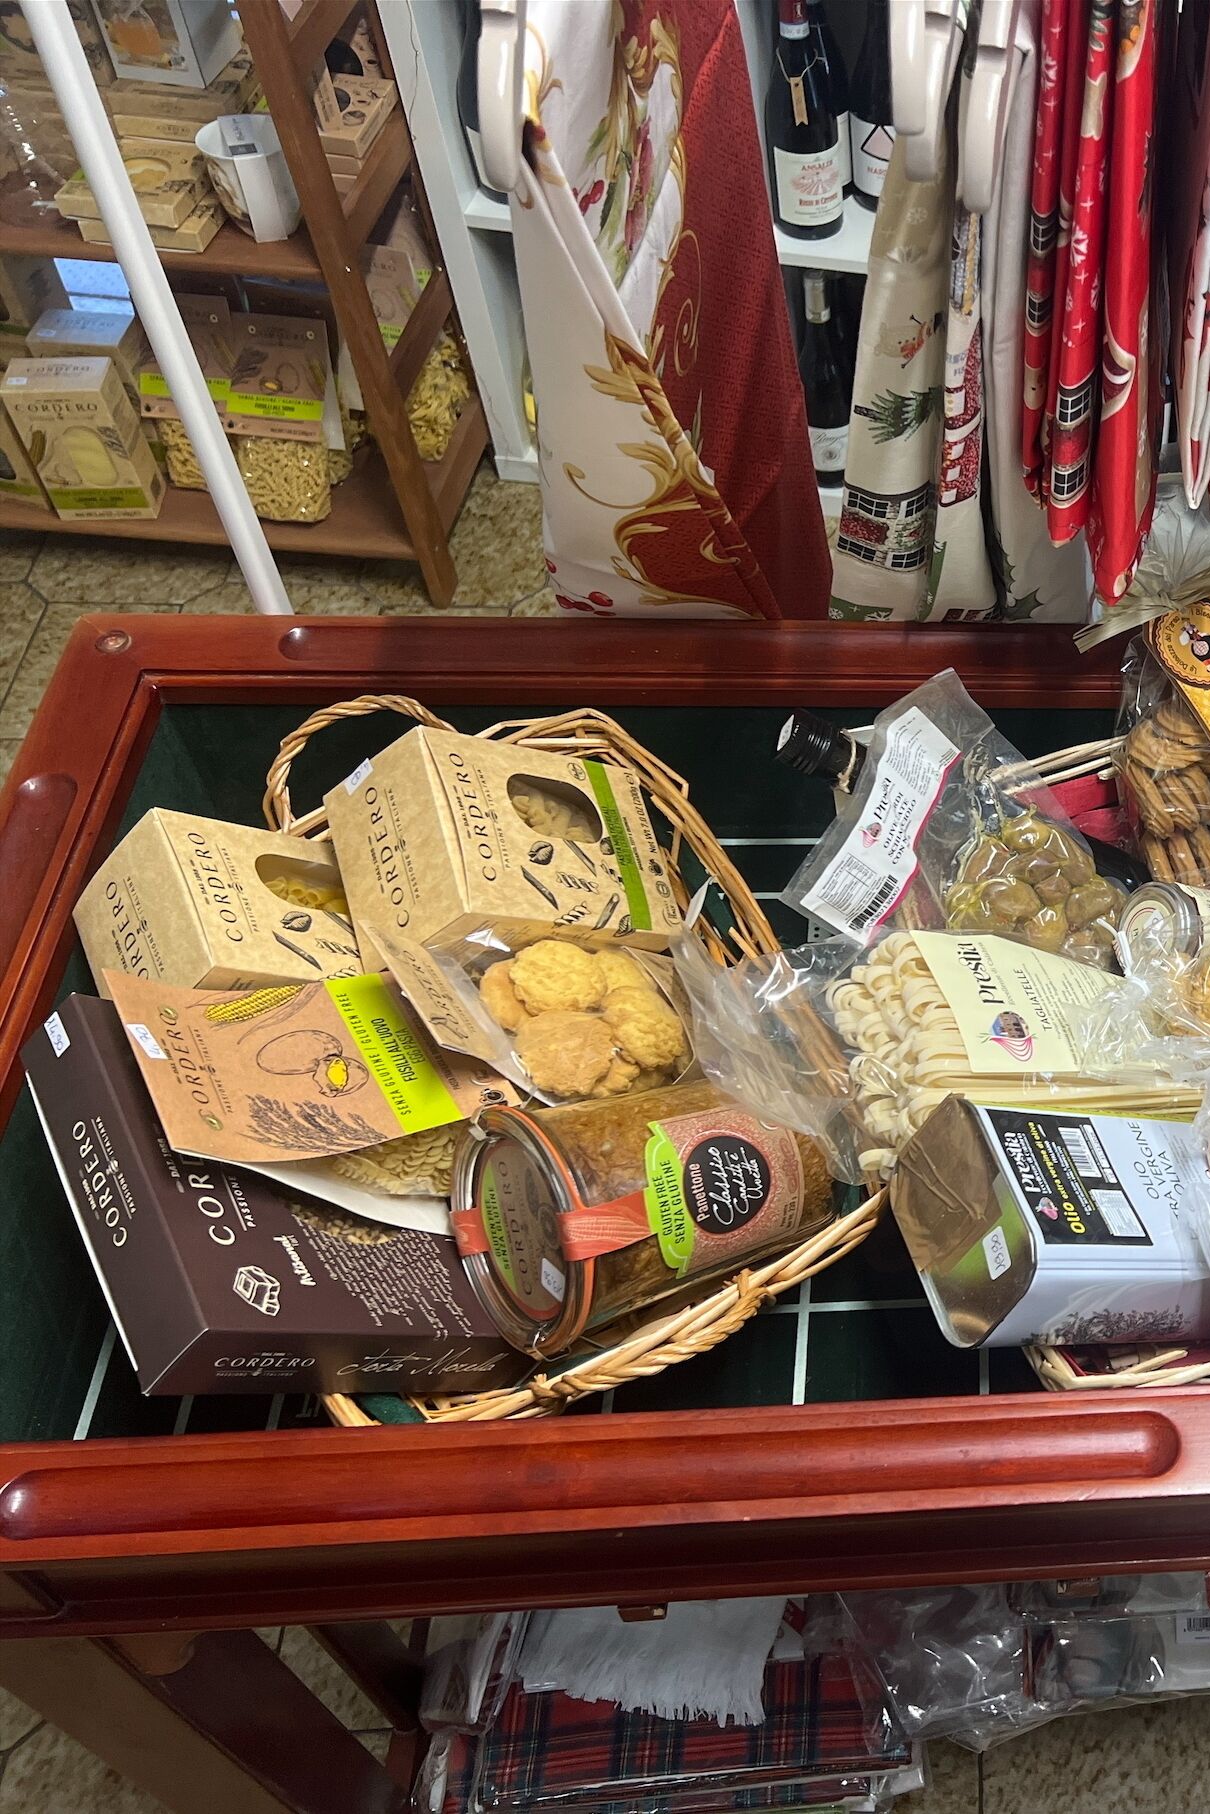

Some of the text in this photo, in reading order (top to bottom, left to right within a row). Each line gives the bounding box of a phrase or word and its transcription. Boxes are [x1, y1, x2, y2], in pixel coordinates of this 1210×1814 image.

[14, 402, 99, 413] CORDERO
[388, 788, 420, 899] PASSIONE ITALIANA
[448, 753, 497, 882] CORDERO
[477, 769, 511, 868] PASSIONE ITALIANA
[187, 832, 244, 942] CORDERO
[365, 787, 410, 927] CORDERO
[221, 847, 261, 933] PASSIONE ITALIANA
[105, 881, 149, 980] ORDERO
[126, 876, 166, 973] PASSIONE ITALIANA
[335, 993, 352, 1012] FREE
[957, 942, 1005, 1005] Prestia
[1013, 968, 1053, 1032] TAGLIATELLE
[349, 1014, 372, 1045] GLUTEN
[370, 1018, 419, 1083] FUSILLI ALL'UOVO
[395, 1027, 426, 1065] EGG PASTA
[215, 1079, 233, 1114] PASSIONE
[368, 1053, 396, 1088] GLUTINE
[389, 1089, 412, 1116] SENZA
[72, 1120, 127, 1248] CORDERO
[95, 1116, 137, 1214] PASSIONE ITALIANA
[166, 1161, 180, 1178] DAL
[740, 1146, 764, 1200] Uvetta
[1004, 1131, 1042, 1194] Prestia
[1027, 1121, 1087, 1234] Olio extra vergine di oliva
[1127, 1121, 1165, 1187] VERGINE
[1133, 1161, 1160, 1200] OLIO
[228, 1175, 256, 1228] PASSIONE
[652, 1174, 674, 1237] GLUTEN FREE
[661, 1159, 686, 1245] SENZA GLUTINE
[688, 1162, 711, 1223] Panettone
[708, 1146, 734, 1226] Classico
[489, 1222, 502, 1258] GLUTEN
[497, 1235, 512, 1271] SENZA
[498, 1161, 533, 1296] CORDERO
[273, 1235, 317, 1287] Artisanal
[213, 1356, 317, 1369] CORDERO
